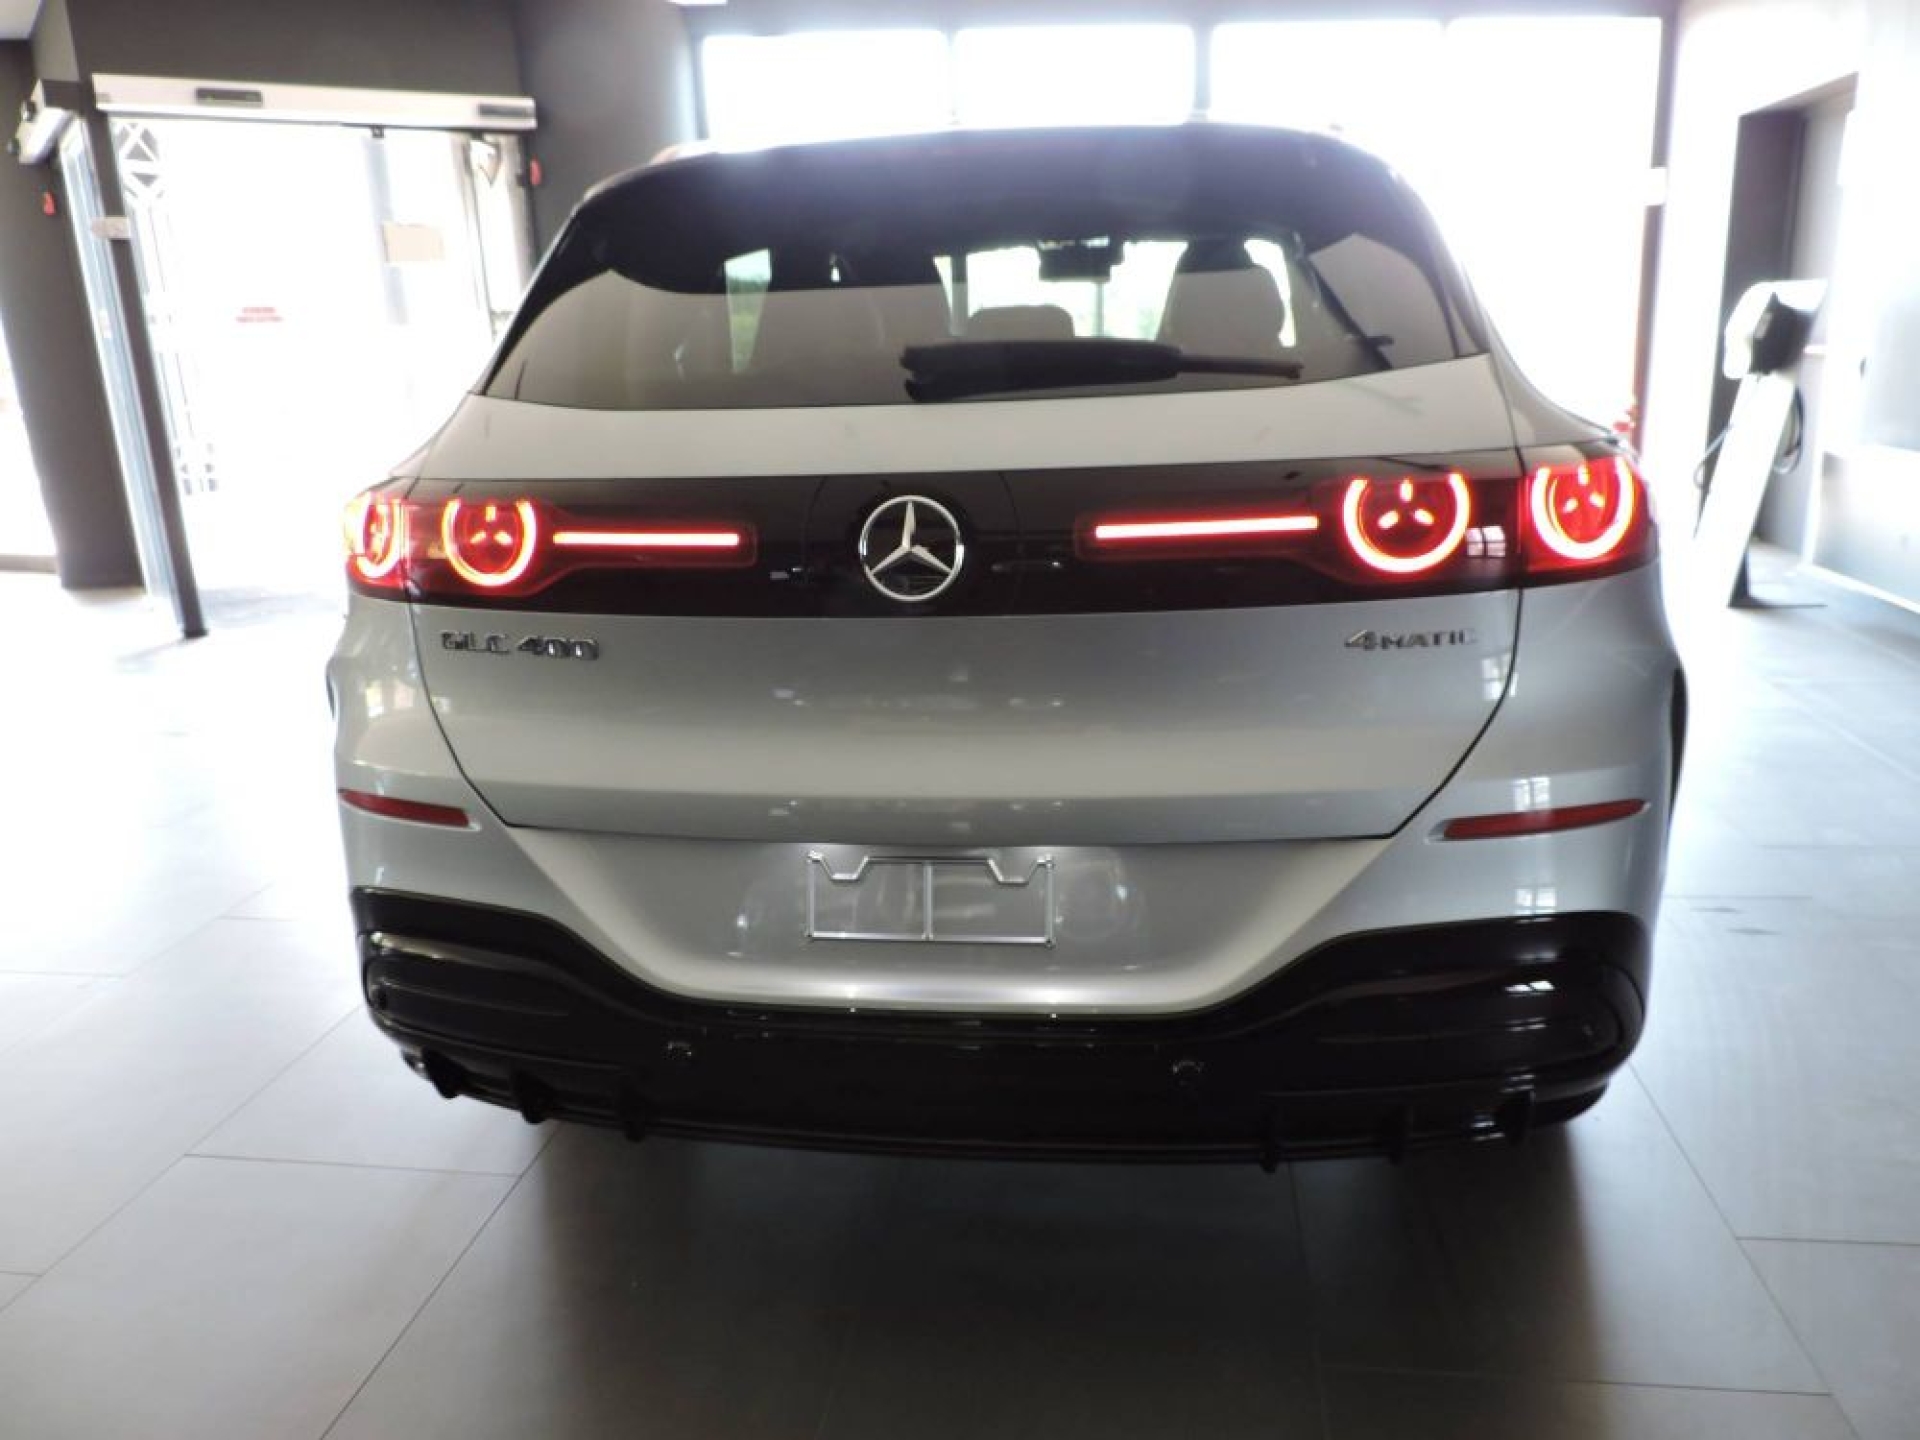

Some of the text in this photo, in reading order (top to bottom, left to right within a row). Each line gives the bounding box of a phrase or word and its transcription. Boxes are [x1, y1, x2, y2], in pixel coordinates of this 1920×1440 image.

[440, 631, 600, 661] GLC 400
[1344, 629, 1478, 650] 4MATIC
